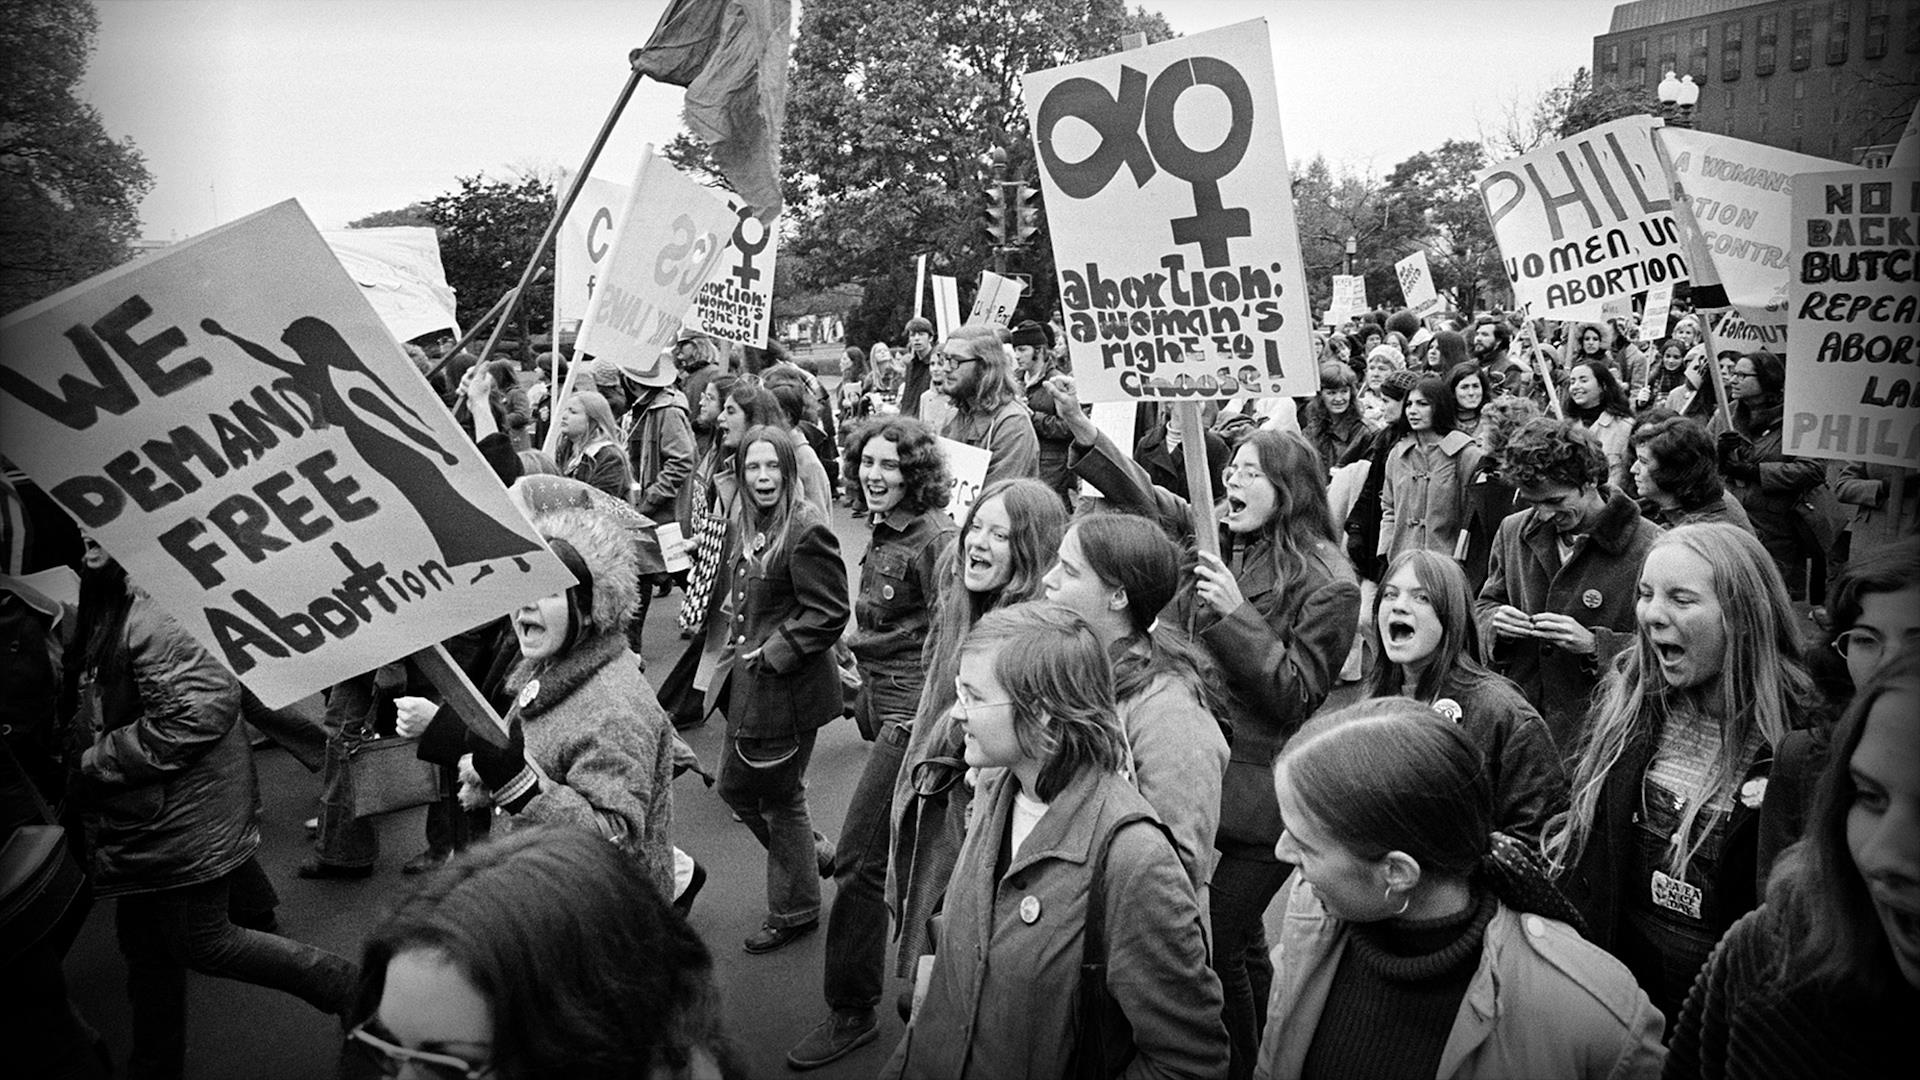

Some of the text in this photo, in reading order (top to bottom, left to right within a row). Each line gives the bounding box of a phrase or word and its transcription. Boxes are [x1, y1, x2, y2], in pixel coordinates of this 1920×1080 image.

[1674, 151, 1690, 173] A
[1686, 195, 1758, 230] TION
[1825, 182, 1892, 214] NO
[1807, 216, 1920, 247] BACK
[1062, 254, 1283, 310] abortion:
[1802, 249, 1920, 284] BUTC
[698, 307, 751, 328] right to
[1798, 291, 1920, 323] REPEA
[0, 294, 213, 430] WE
[1101, 334, 1254, 374] right to
[1816, 331, 1920, 366] ABOR
[50, 377, 330, 528] DEMAND
[158, 449, 380, 590] FREE
[203, 541, 455, 676] Abortion
